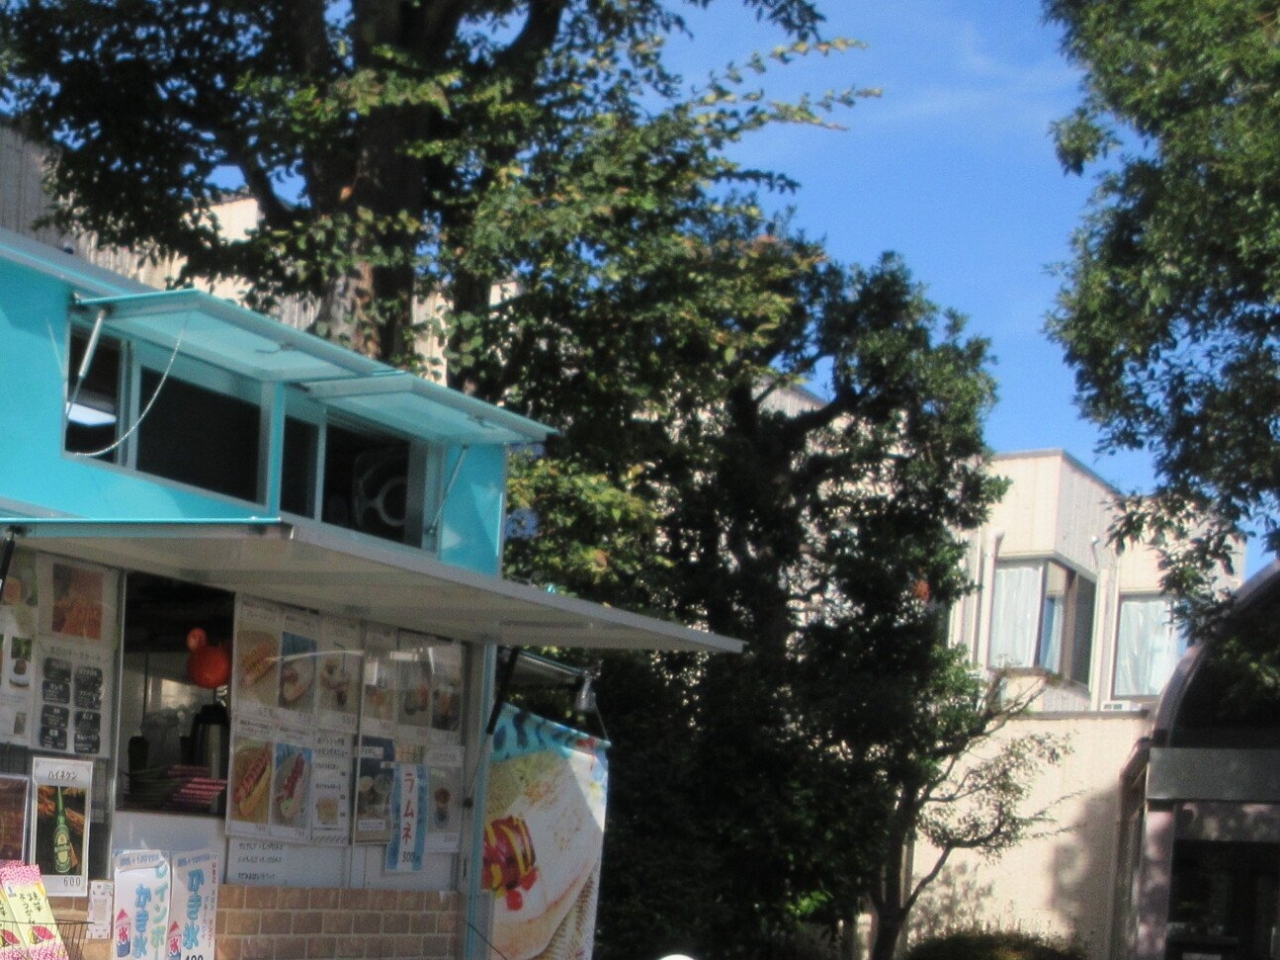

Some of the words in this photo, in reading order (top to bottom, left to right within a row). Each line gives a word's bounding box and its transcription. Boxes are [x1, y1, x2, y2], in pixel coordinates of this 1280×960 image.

[402, 771, 415, 845] ラムネ
[63, 876, 82, 887] 600
[182, 868, 205, 950] かき氷
[132, 883, 152, 959] かき氷
